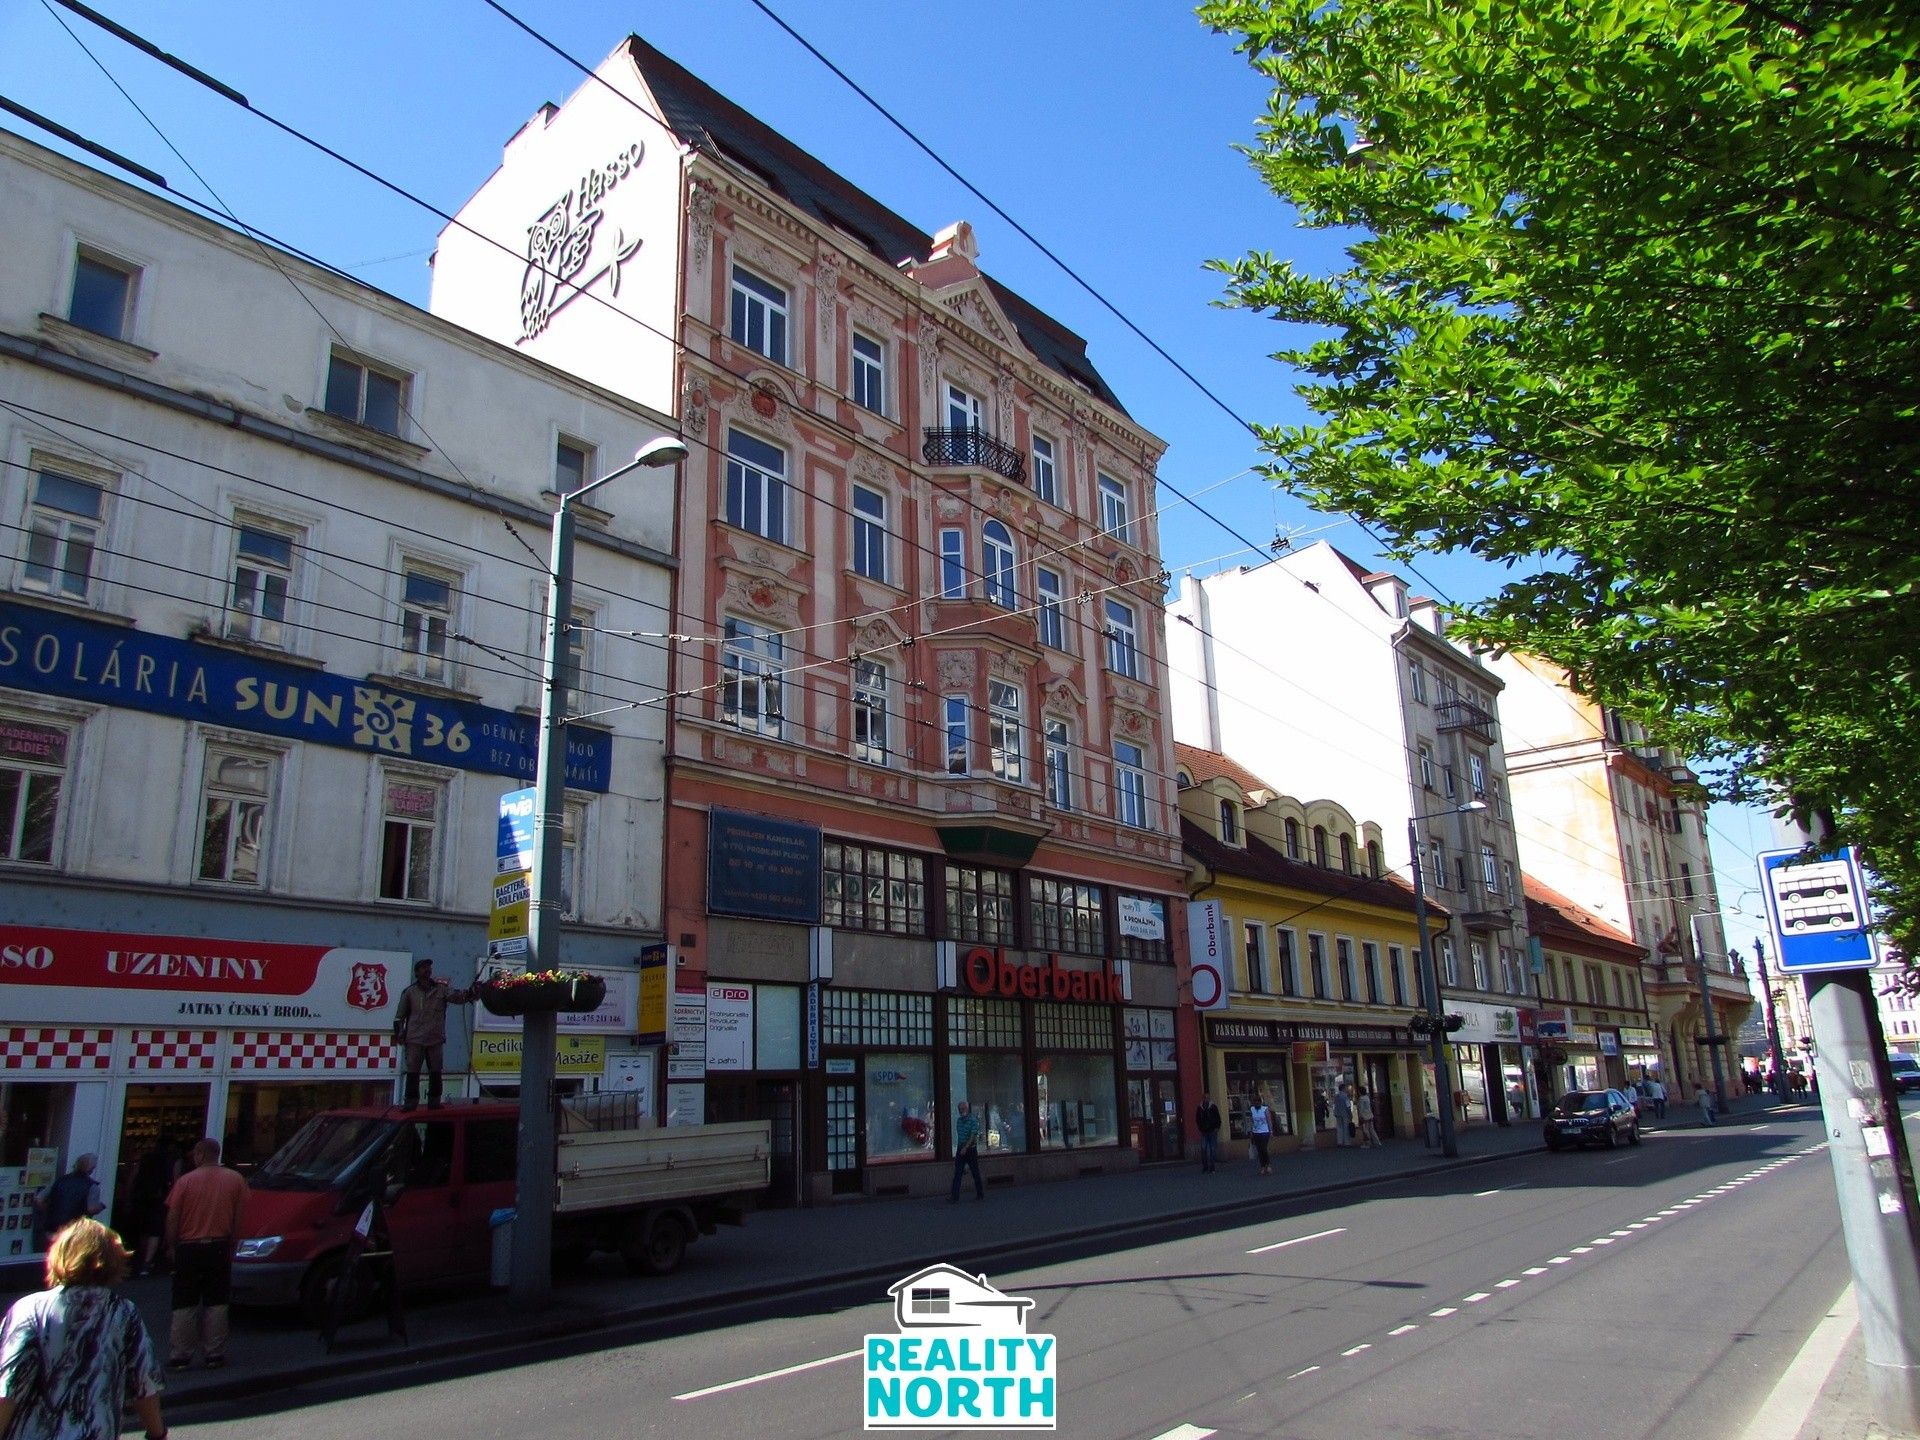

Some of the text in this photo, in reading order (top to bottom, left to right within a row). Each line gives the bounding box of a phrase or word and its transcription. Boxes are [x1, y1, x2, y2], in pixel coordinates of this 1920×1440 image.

[576, 139, 645, 218] Hasso
[0, 627, 471, 752] SOLÁRIA SUN 36
[8, 740, 50, 757] LADIES
[490, 748, 511, 768] BEZ
[1207, 903, 1217, 957] Oberbank
[106, 950, 271, 981] UZENINY
[965, 946, 1125, 1003] Oberbank
[178, 1002, 225, 1015] JATKY
[228, 1001, 271, 1016] ČESKÝ
